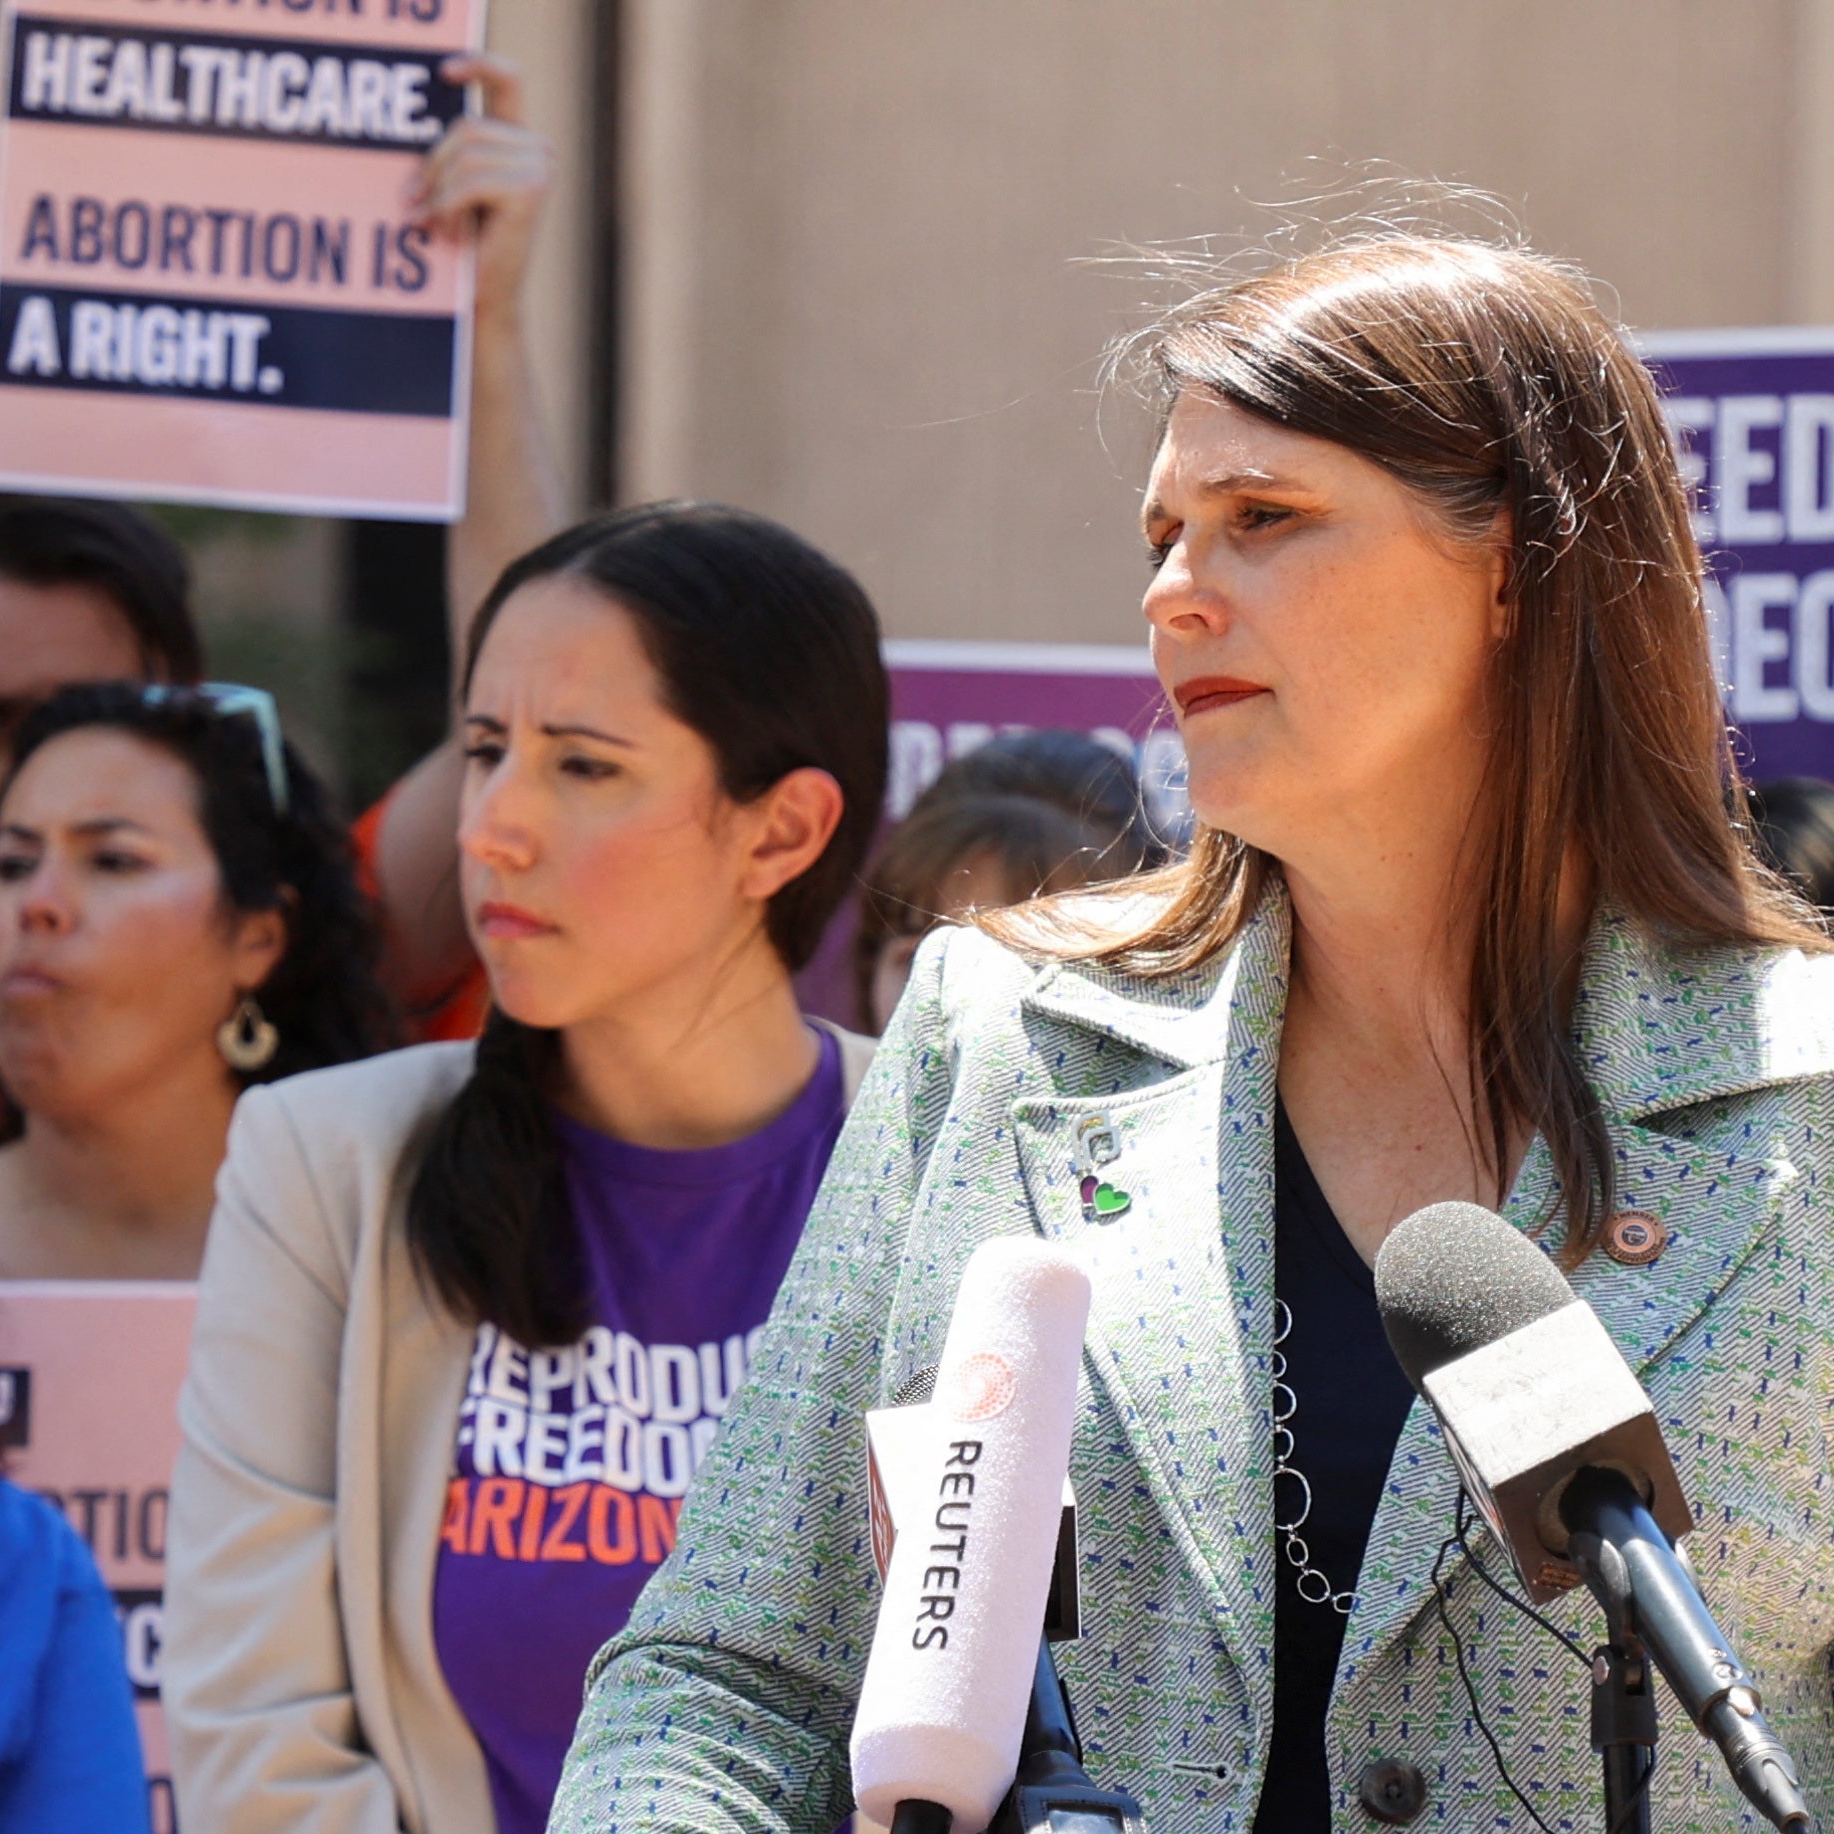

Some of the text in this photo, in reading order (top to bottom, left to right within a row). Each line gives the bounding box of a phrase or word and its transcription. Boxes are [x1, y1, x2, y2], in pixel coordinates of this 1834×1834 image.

[21, 30, 444, 143] HEALTHCARE.
[20, 192, 431, 293] ABORTION IS
[8, 295, 285, 394] A RIGHT.
[442, 1476, 685, 1566] ARIZON
[911, 1440, 984, 1651] REUTERS
